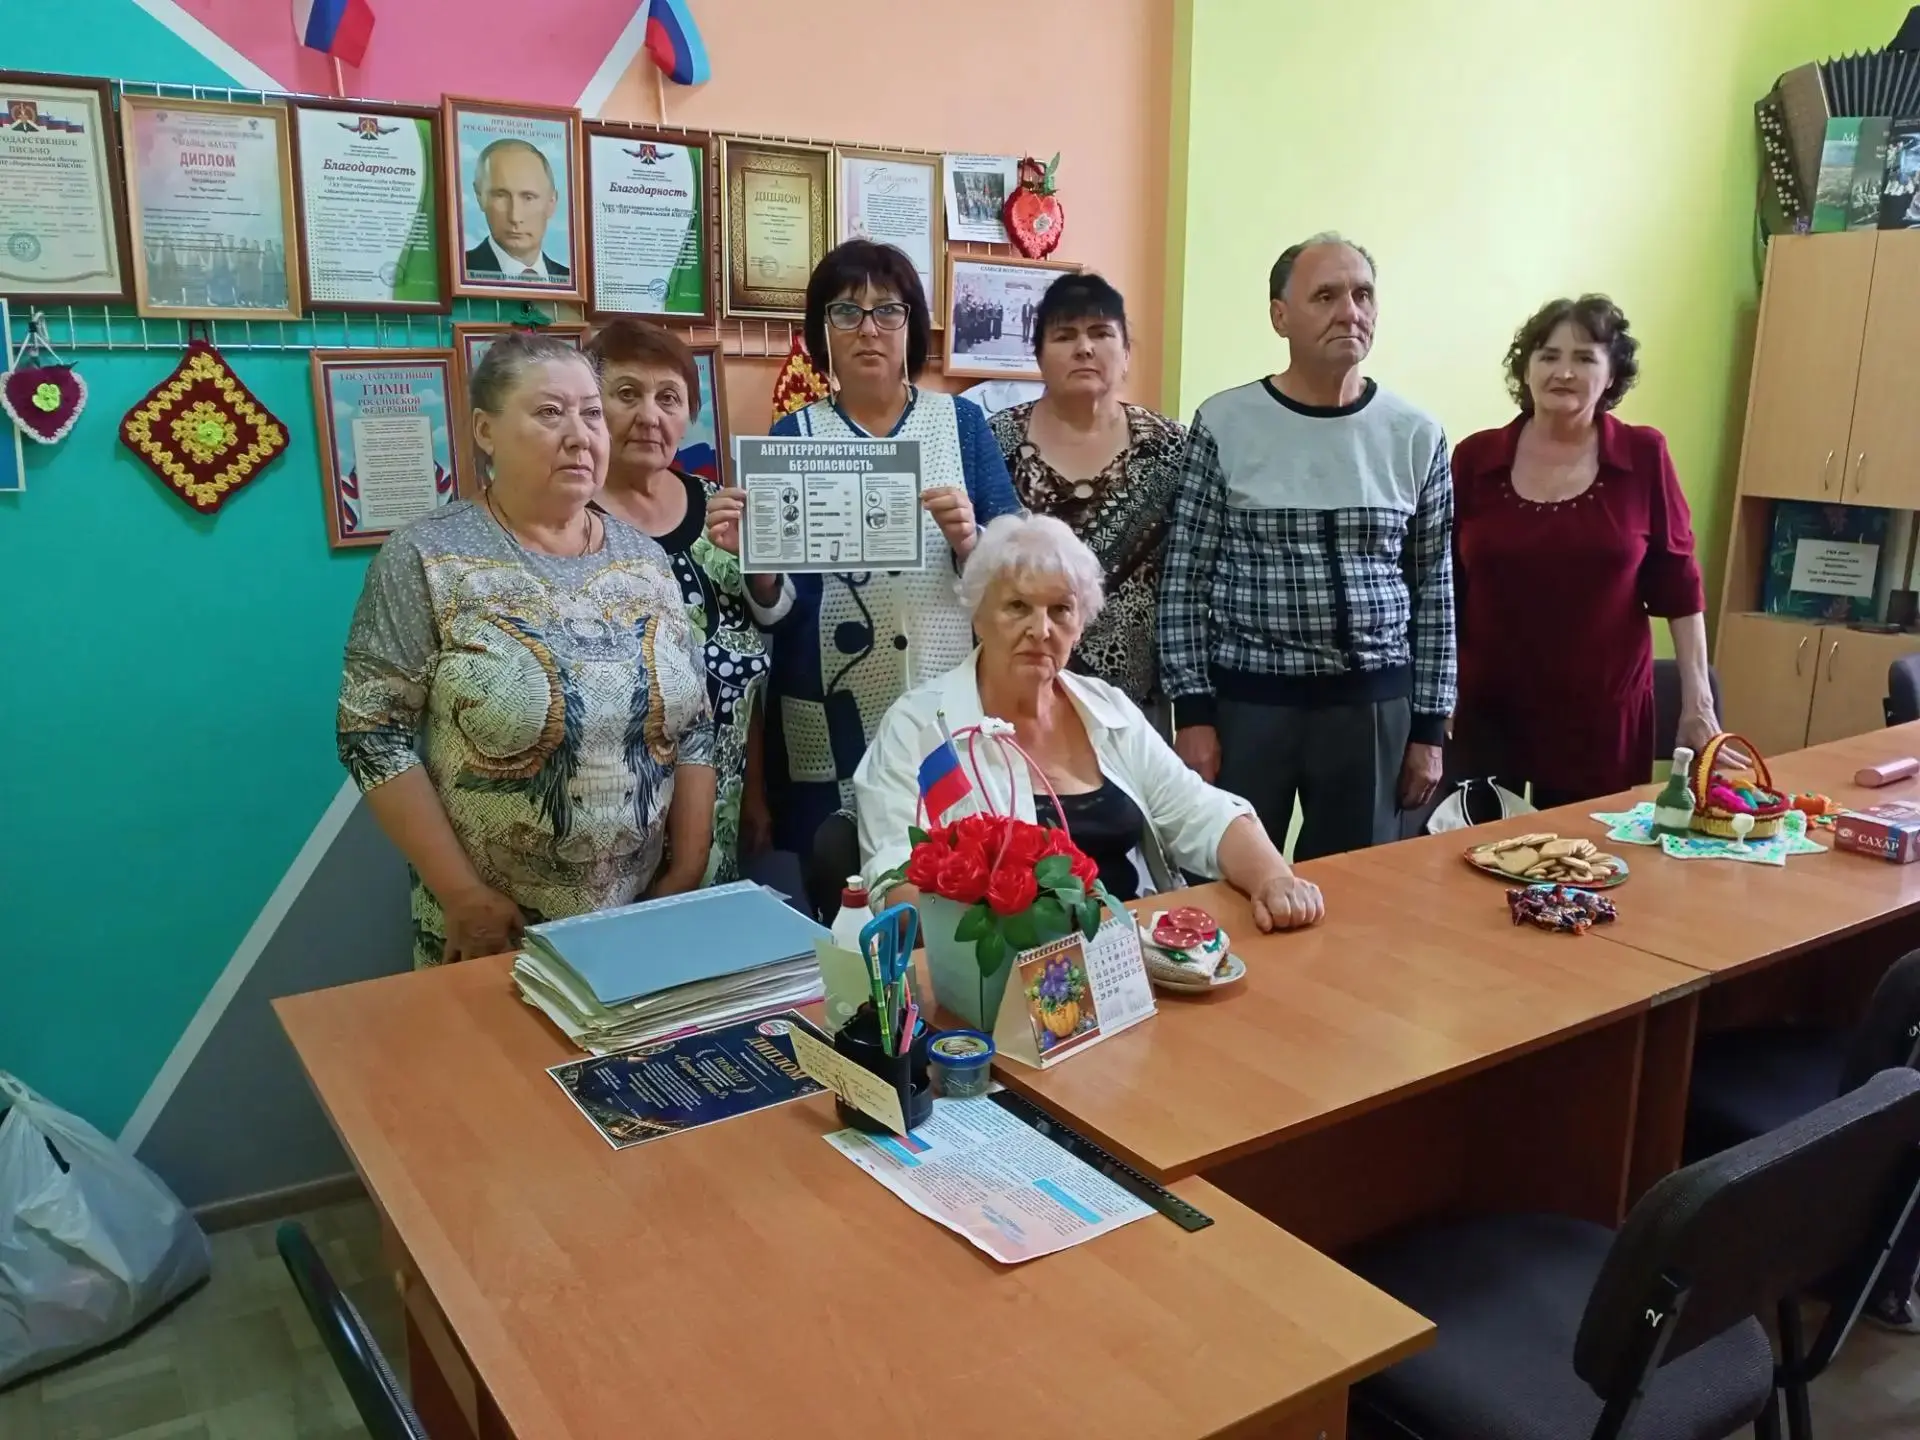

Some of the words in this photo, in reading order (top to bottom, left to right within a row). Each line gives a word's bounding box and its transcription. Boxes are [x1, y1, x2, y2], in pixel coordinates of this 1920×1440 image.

[0, 134, 78, 147] ОДАРСТВЕННОЕ
[180, 151, 236, 168] ДИПЛОМ
[322, 158, 417, 176] Благодарность
[609, 181, 688, 198] Благодарность
[362, 383, 411, 395] ГИМН
[760, 443, 897, 457] АНТИТЕРРОРИСТИЧЕСКАЯ
[789, 459, 874, 473] БЕЗОПАСНОСТЬ
[1858, 833, 1900, 852] САХАР
[744, 1036, 809, 1080] ДИПЛОМ
